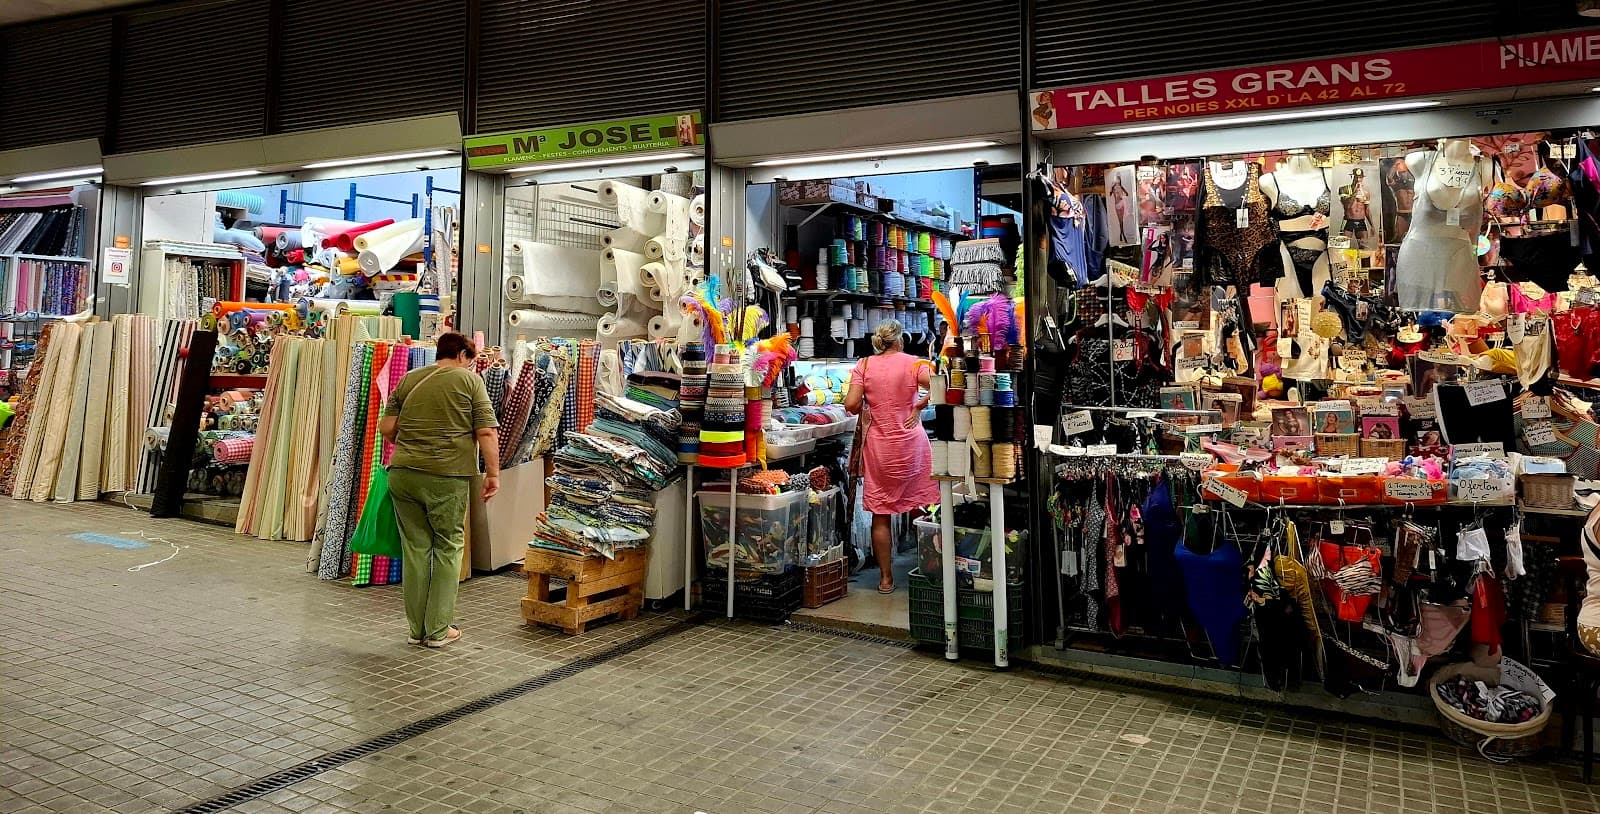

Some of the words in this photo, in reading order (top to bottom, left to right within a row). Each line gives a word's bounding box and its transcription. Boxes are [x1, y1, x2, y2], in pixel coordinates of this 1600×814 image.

[1067, 77, 1218, 111] TALLES
[1231, 58, 1393, 94] GRANS
[1123, 107, 1159, 119] PER
[1164, 100, 1219, 115] NOIES
[1224, 97, 1262, 110] XXL
[1317, 89, 1339, 100] 42
[1350, 85, 1377, 97] AL
[1383, 82, 1406, 93] 72
[558, 123, 653, 150] JOSE
[503, 154, 536, 162] FLAMENC
[572, 145, 628, 156] COMPLEMENTS
